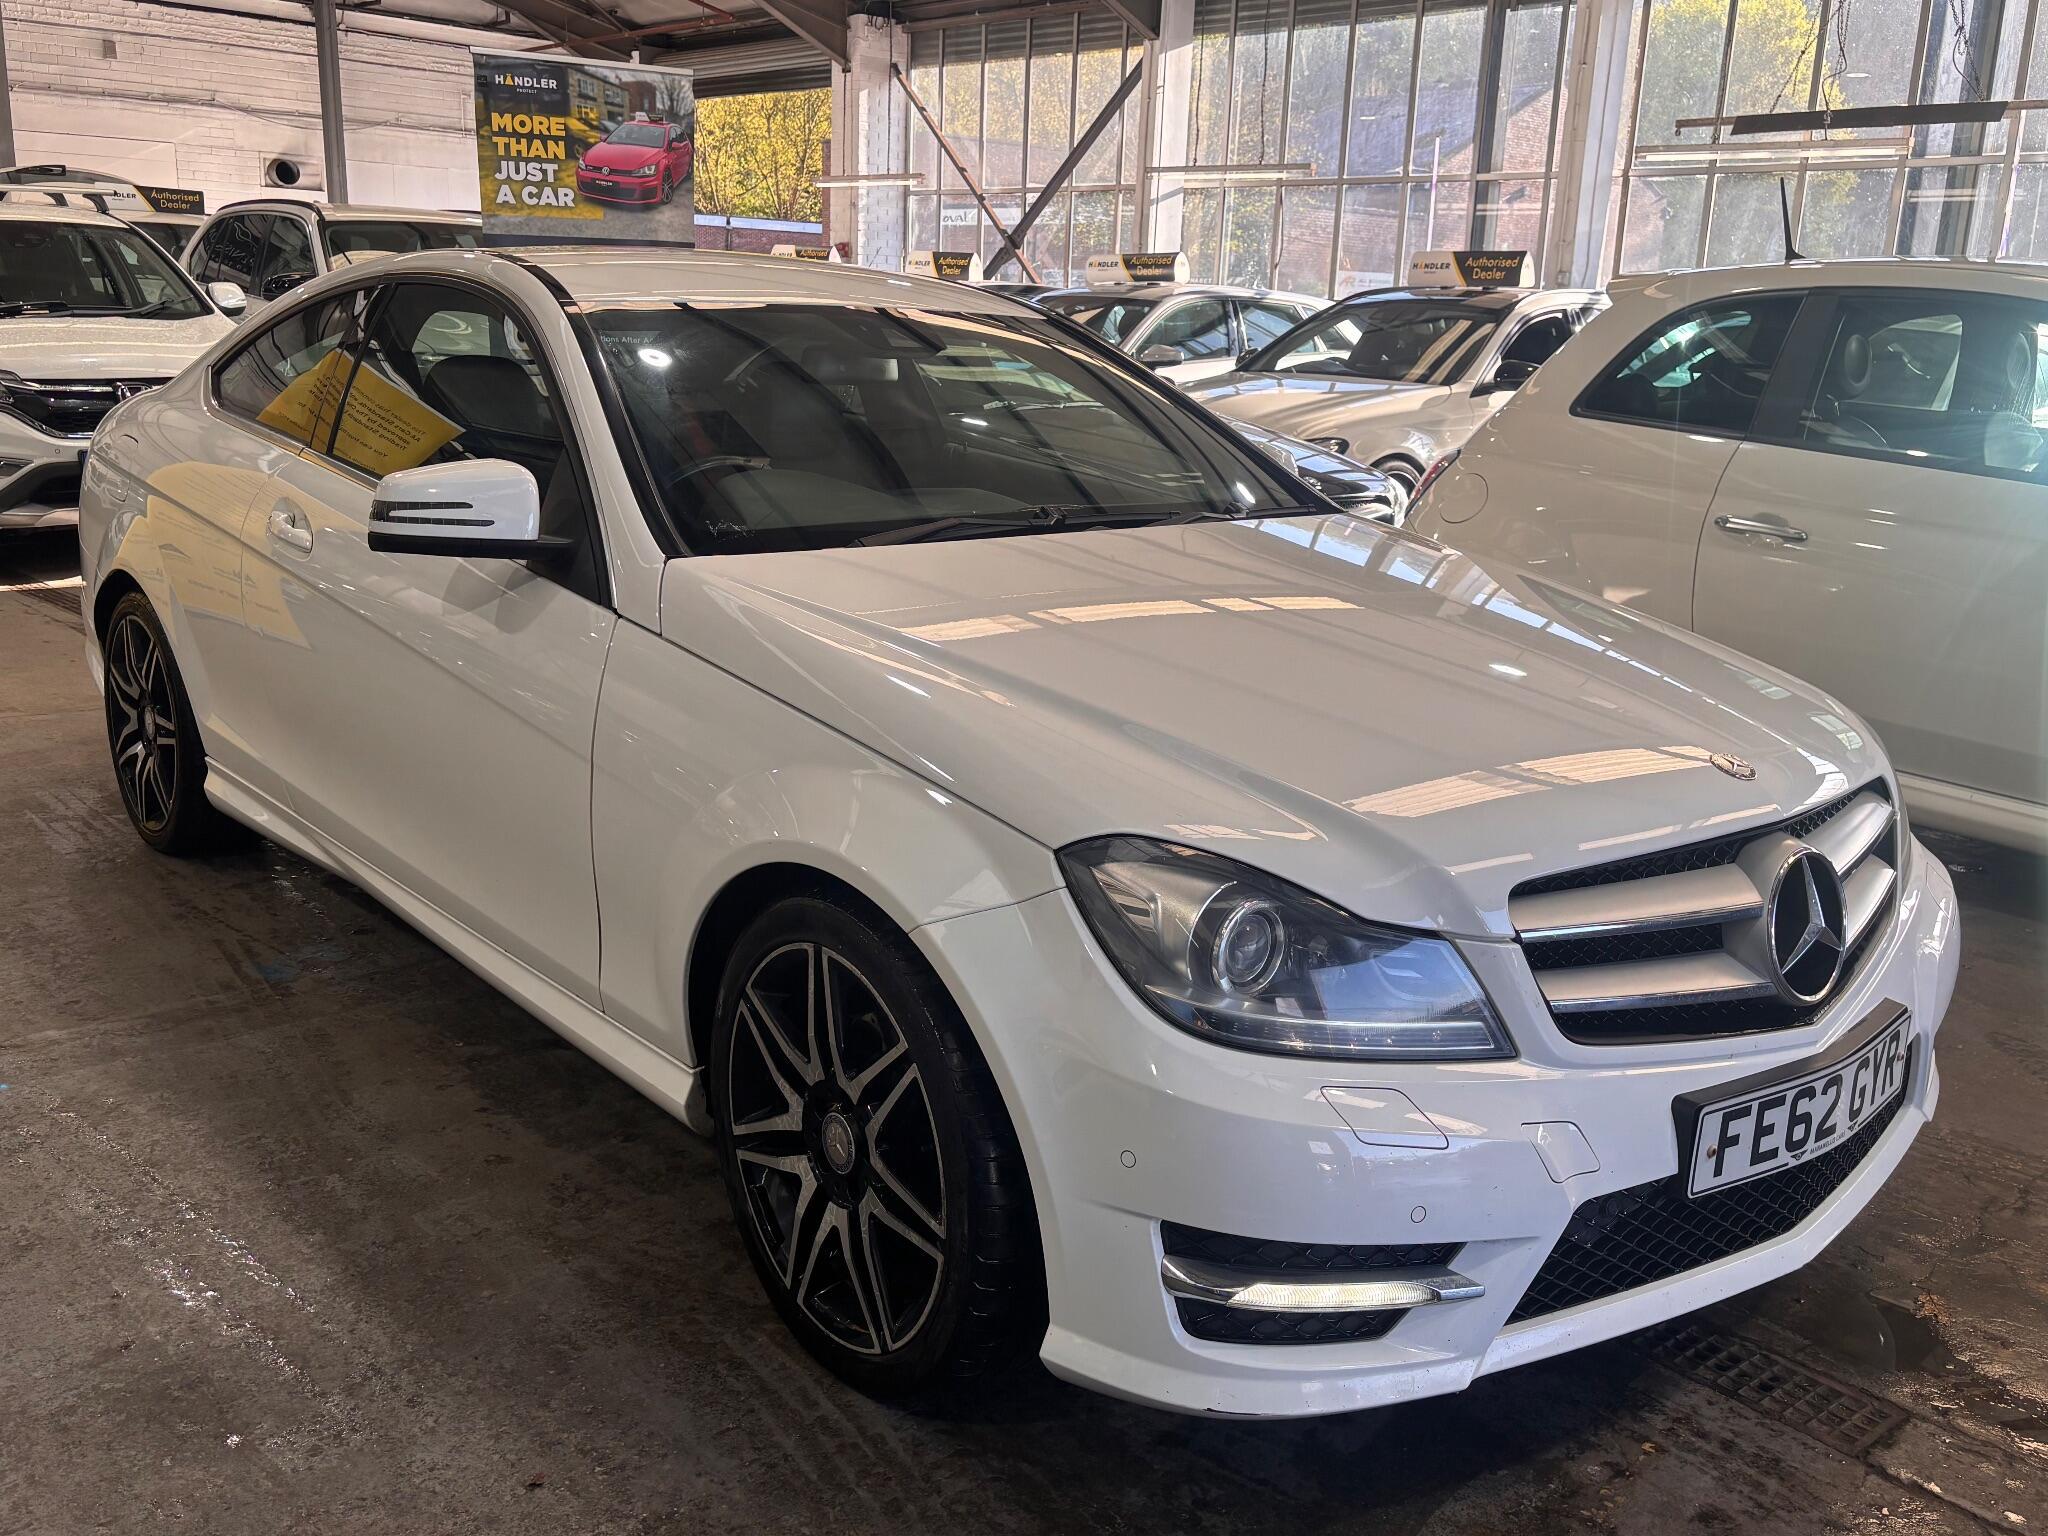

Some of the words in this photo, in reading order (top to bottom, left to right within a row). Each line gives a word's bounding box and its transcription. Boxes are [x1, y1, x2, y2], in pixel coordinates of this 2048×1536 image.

[491, 112, 566, 136] MORE
[491, 136, 566, 160] THAN
[494, 160, 559, 183] JUST
[151, 189, 200, 202] Authorised
[495, 184, 517, 205] A
[521, 185, 576, 208] CAR
[160, 199, 190, 210] Dealer
[938, 256, 970, 266] Authorised
[1130, 255, 1173, 265] Authorised
[1465, 255, 1520, 268] Authorised
[942, 265, 961, 275] Dealer
[1136, 265, 1164, 276] Dealer
[1472, 267, 1506, 280] Dealer
[1713, 1074, 1844, 1179] FE62
[1848, 1028, 1902, 1123] GYR
[1809, 1136, 1836, 1155] MARANELLO
